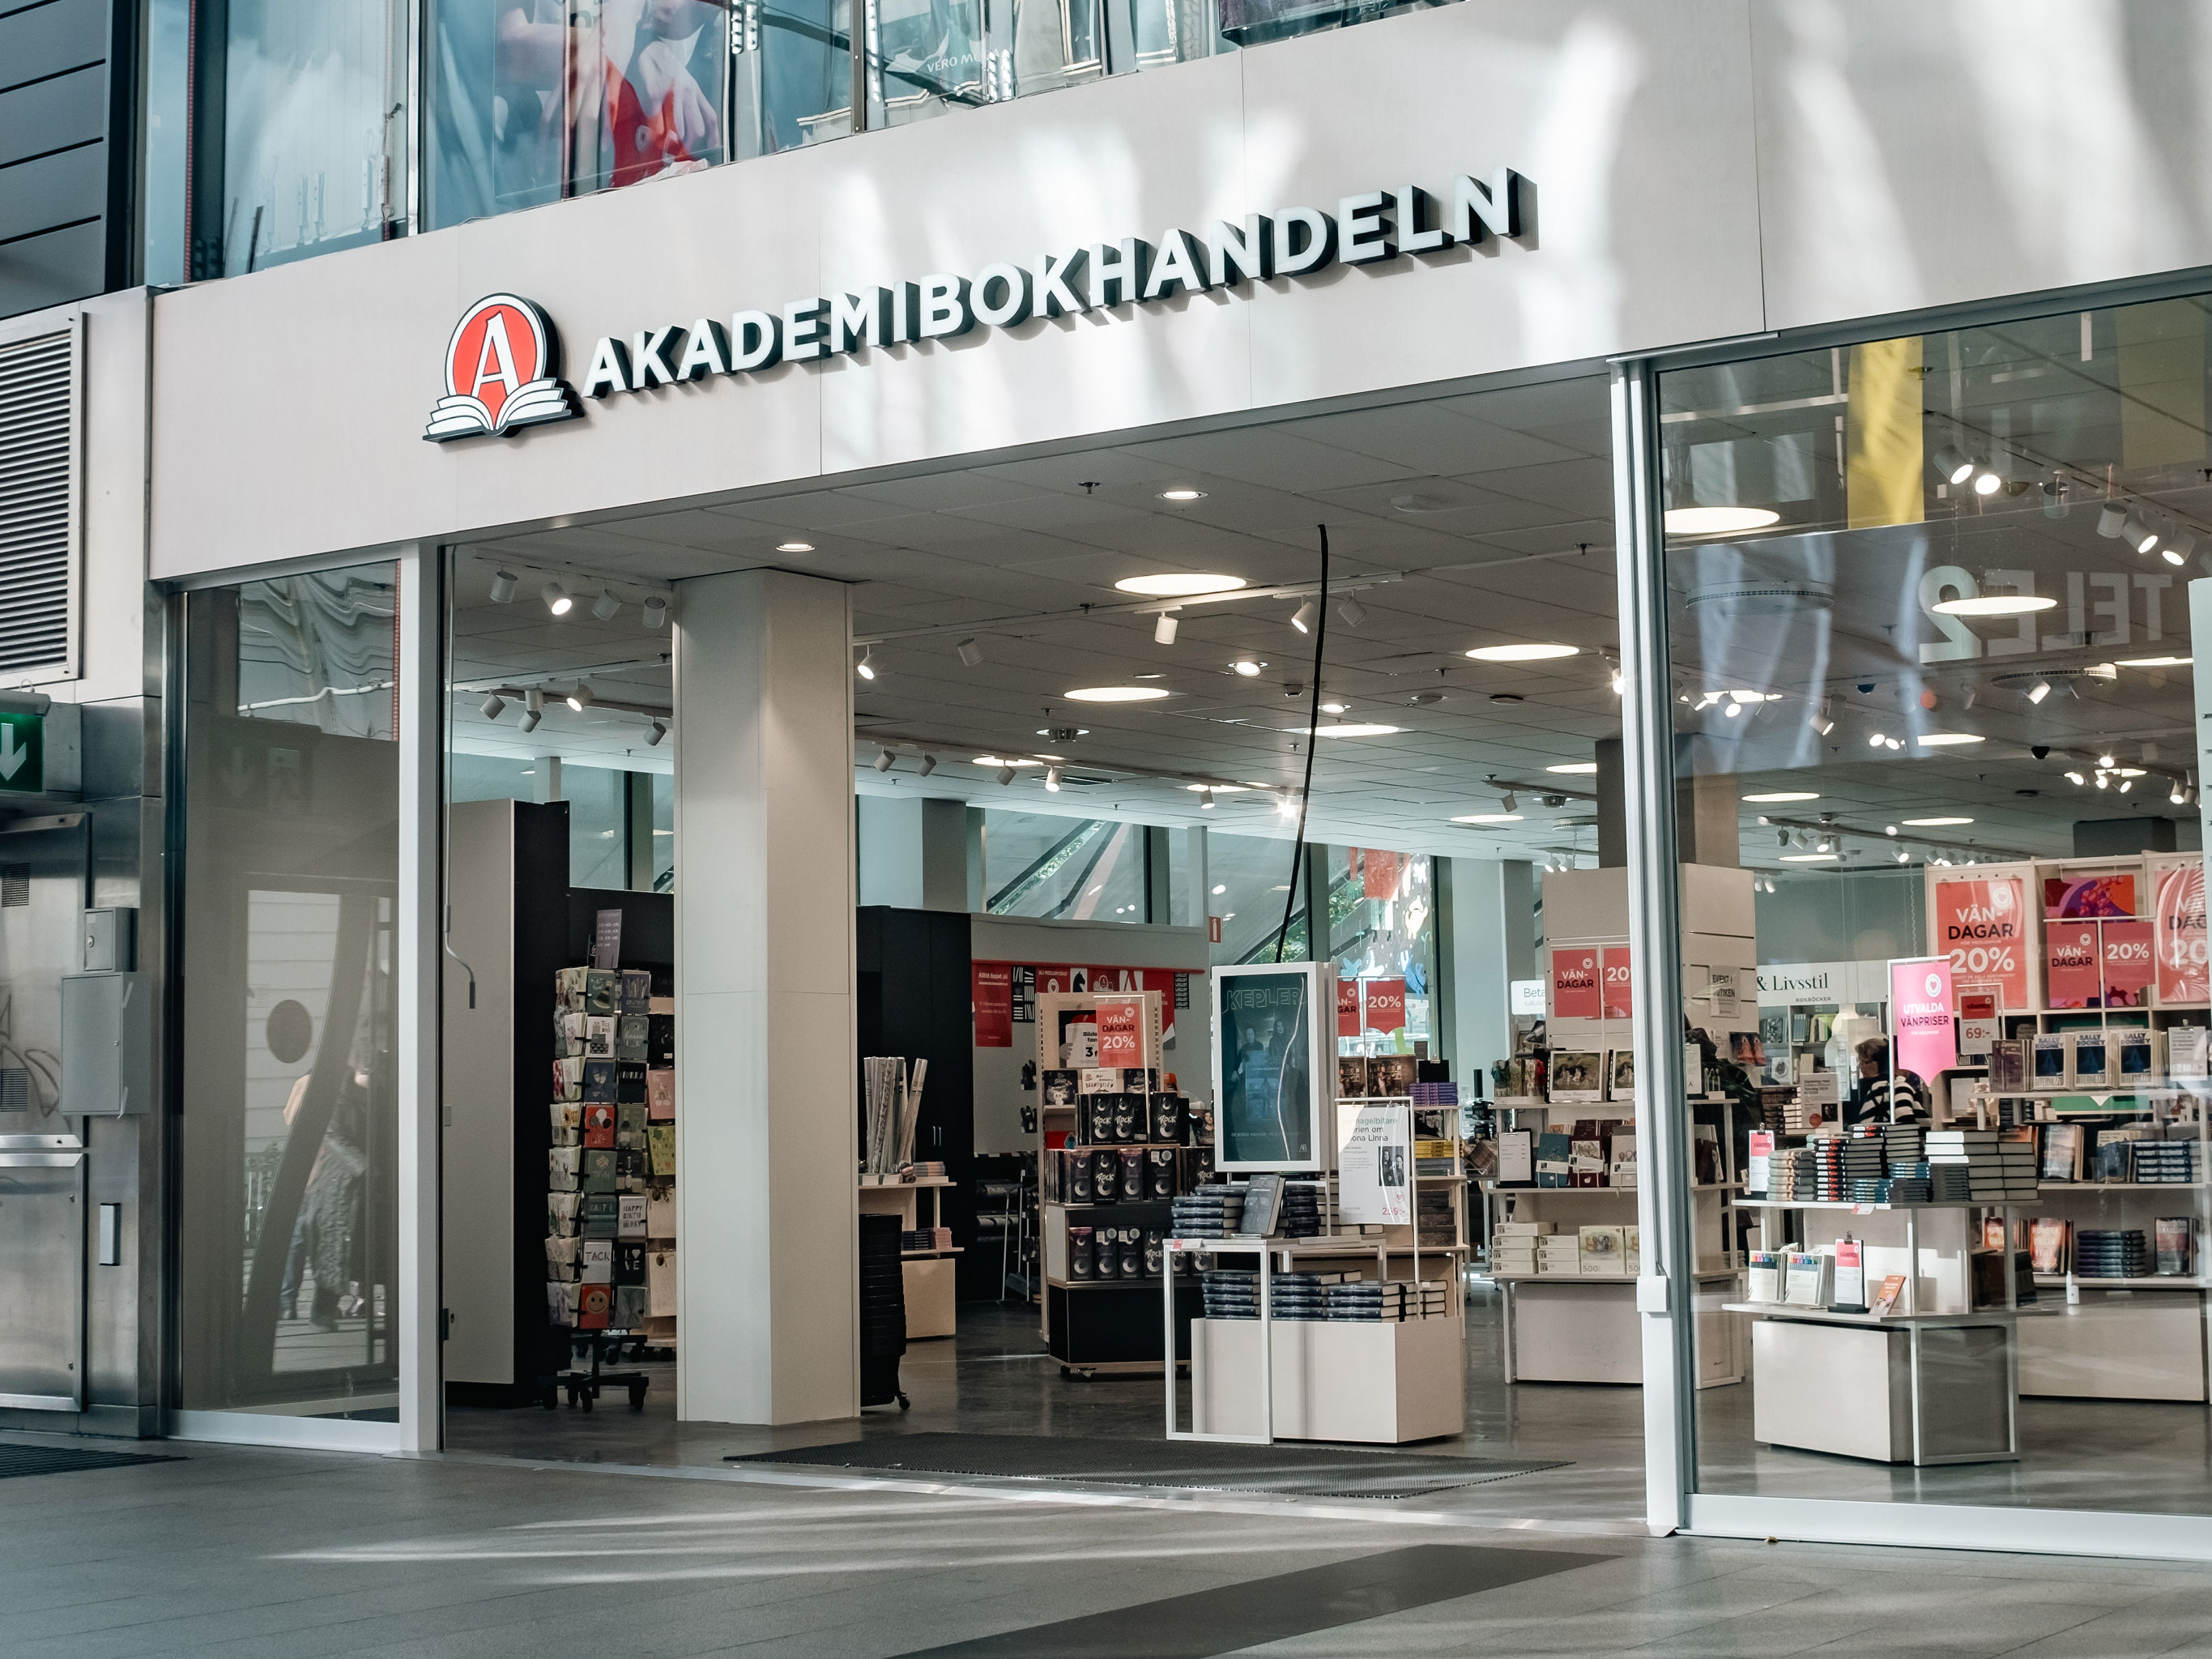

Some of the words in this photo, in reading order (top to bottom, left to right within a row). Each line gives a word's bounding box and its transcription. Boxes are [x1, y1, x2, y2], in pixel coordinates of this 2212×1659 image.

[927, 57, 957, 72] VERO
[582, 167, 1523, 399] AKADEMIBOKHANDELN
[471, 312, 520, 398] A
[1956, 904, 2003, 923] VÄN-
[1948, 923, 2014, 940] DAGAR
[2056, 945, 2086, 957] VÄN-
[2107, 943, 2150, 960] 20%
[1950, 946, 2015, 973] 20%
[2052, 957, 2093, 967] DAGAR
[1562, 969, 1588, 979] VÄN-
[1607, 966, 1631, 982] 20
[1557, 979, 1594, 988] DAGAR
[1757, 975, 1768, 992] &
[1773, 972, 1829, 991] Livsstil
[1225, 987, 1302, 1012] KEPLER
[1368, 996, 1401, 1009] 20%
[1903, 1002, 1944, 1015] UTVALDA
[1106, 1014, 1131, 1024] VÄN-
[1901, 1015, 1949, 1027] VÄNPRISER
[1102, 1024, 1135, 1033] DAGAR
[1102, 1035, 1136, 1049] 20%
[1093, 1115, 1111, 1127] ROCK
[1115, 1115, 1133, 1127] ROCK
[1157, 1115, 1177, 1127] ROCK
[1095, 1172, 1115, 1184] ROCK
[586, 1252, 611, 1261] TACK
